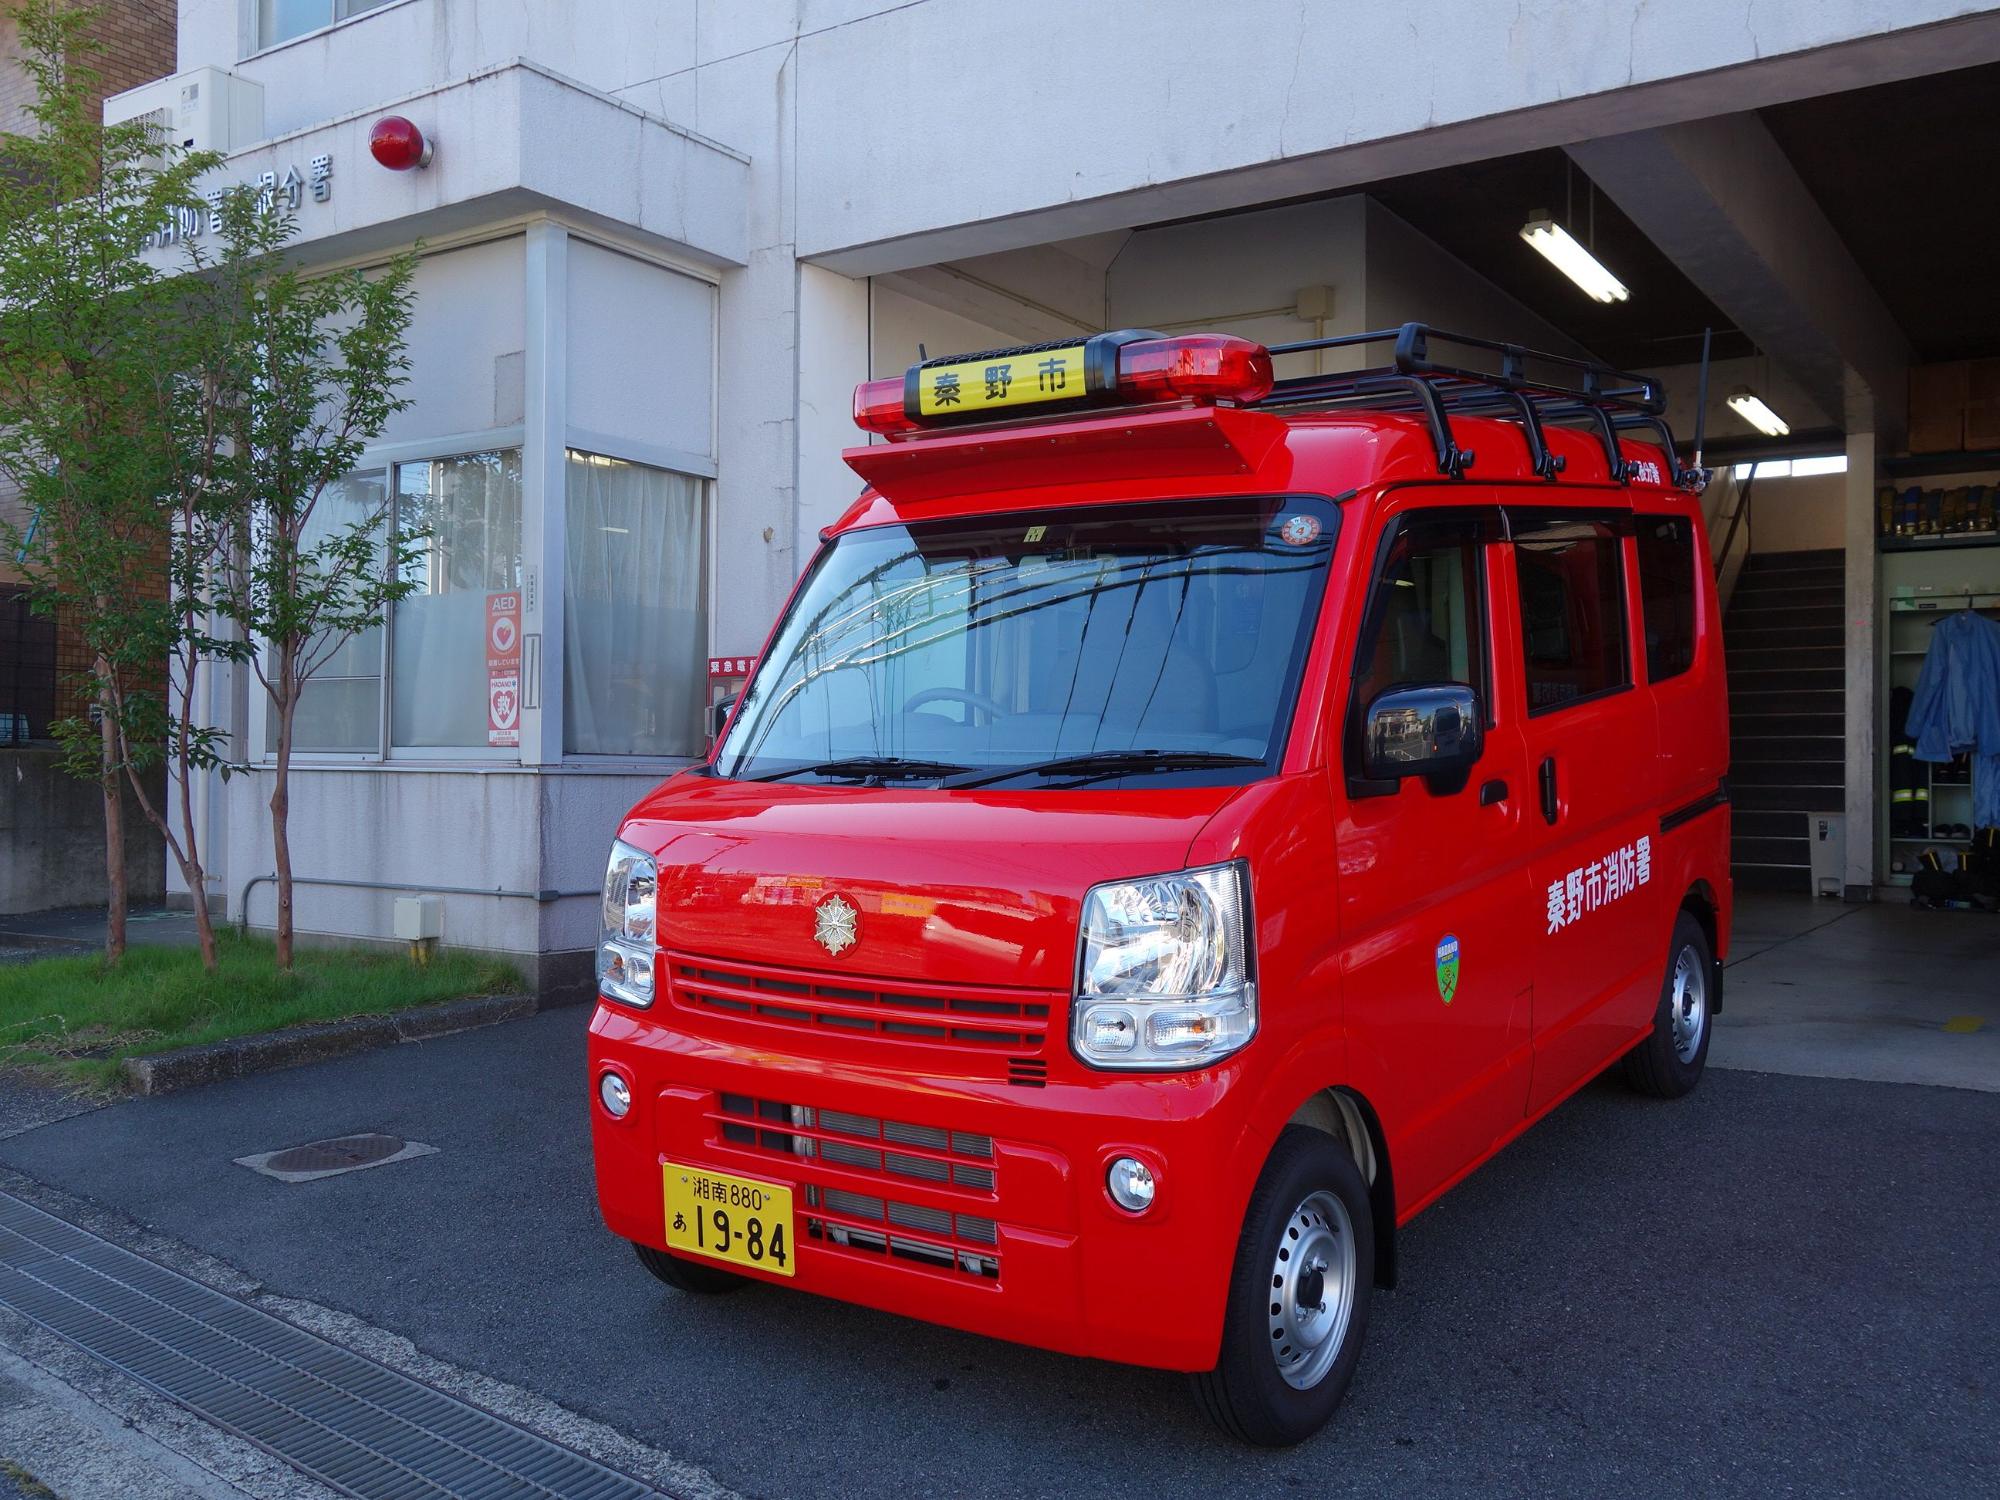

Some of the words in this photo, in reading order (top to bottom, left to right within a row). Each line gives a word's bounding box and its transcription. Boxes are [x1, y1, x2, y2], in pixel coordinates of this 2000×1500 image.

[934, 358, 1067, 407] 秦野市
[492, 597, 516, 610] AED
[1547, 835, 1651, 935] 秦野市消防署
[673, 1211, 687, 1232] あ
[697, 1205, 786, 1267] 19-84
